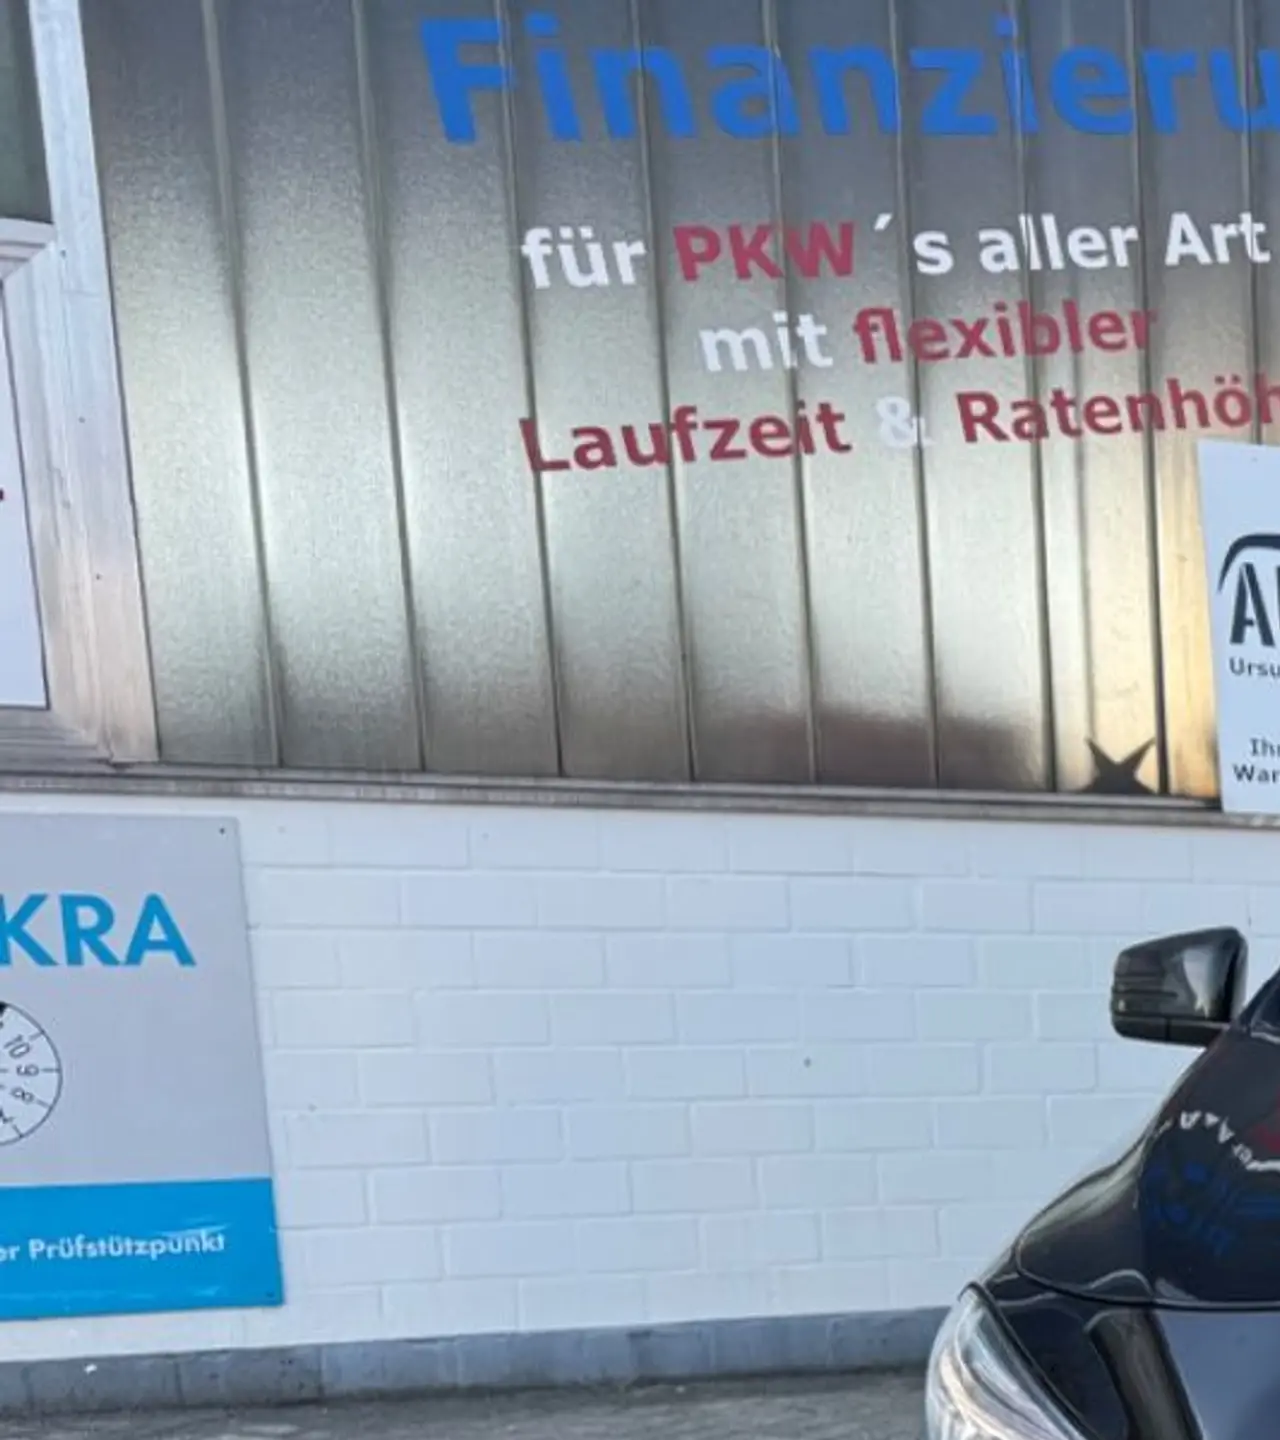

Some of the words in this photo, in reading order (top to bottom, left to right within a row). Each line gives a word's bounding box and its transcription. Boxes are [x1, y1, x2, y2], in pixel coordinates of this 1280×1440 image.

[522, 226, 646, 288] für
[978, 214, 1140, 272] aller
[1164, 211, 1271, 267] Art
[699, 313, 833, 372] mit
[852, 300, 1158, 364] flexibler
[520, 403, 851, 474] Laufzeit
[876, 398, 932, 450] &
[28, 1229, 226, 1262] Prüfstützpunkt
